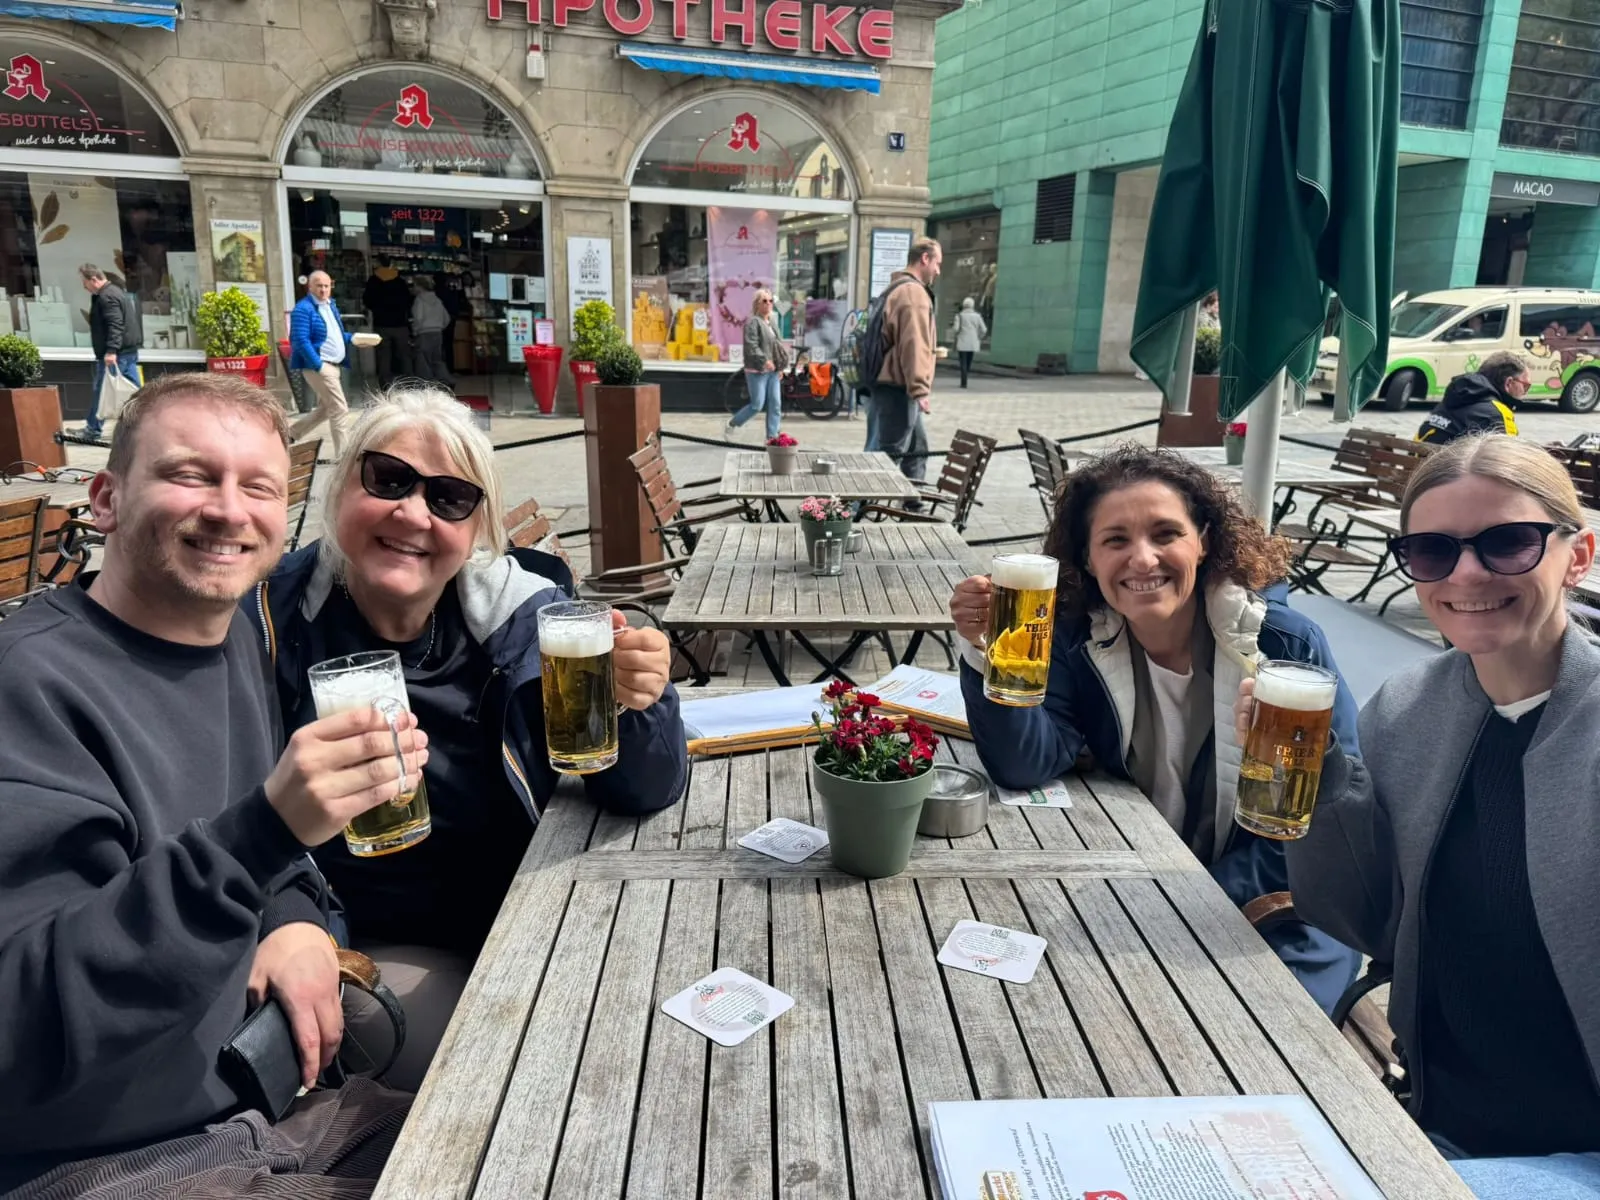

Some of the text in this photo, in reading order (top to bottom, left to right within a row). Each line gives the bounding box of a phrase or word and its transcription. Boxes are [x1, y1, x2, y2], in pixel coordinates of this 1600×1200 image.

[16, 131, 117, 149] mehr als eine Apotheke
[1513, 180, 1553, 196] MACAO
[391, 208, 445, 222] seit 1322
[226, 360, 247, 370] 1322
[1024, 622, 1051, 633] THIE
